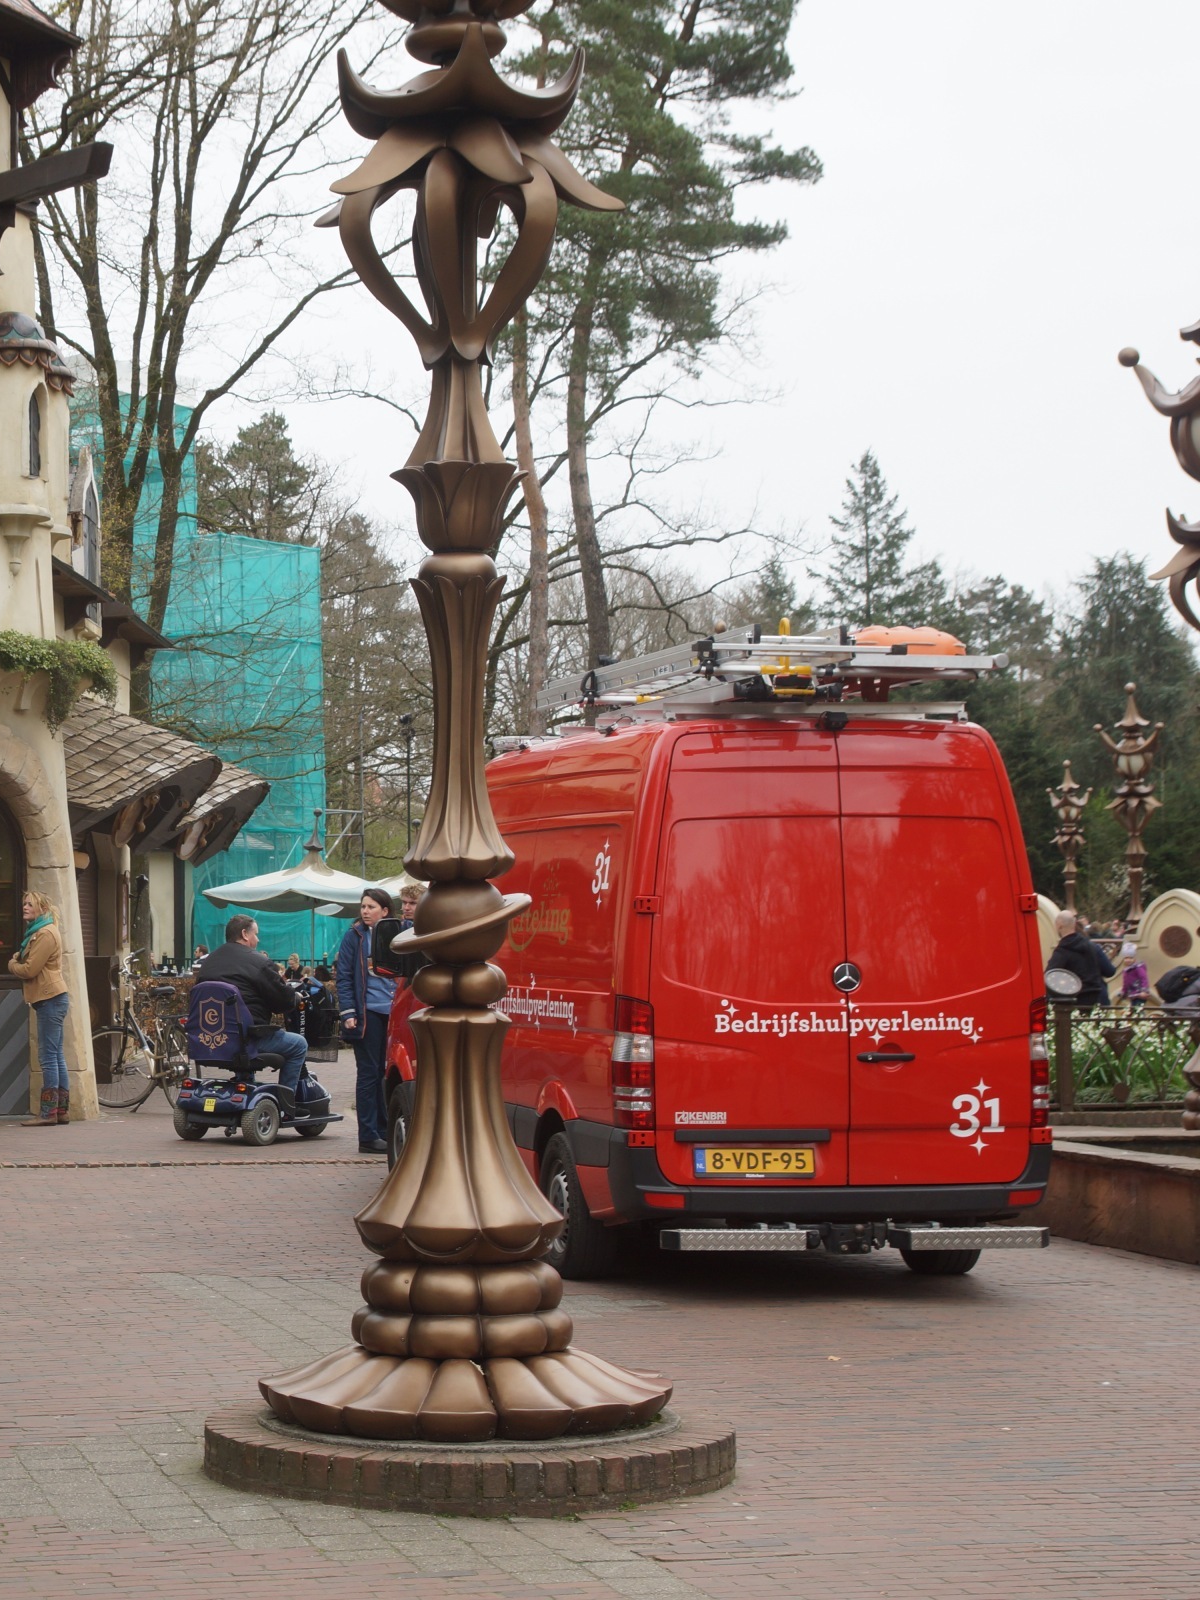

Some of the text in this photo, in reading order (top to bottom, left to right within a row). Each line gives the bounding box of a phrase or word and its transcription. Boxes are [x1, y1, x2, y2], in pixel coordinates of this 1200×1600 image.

[592, 852, 611, 894] 31
[487, 988, 575, 1026] rijfshulpverlening
[715, 1011, 974, 1038] Bedrijfshulpverlening
[688, 1111, 727, 1120] KENBRI
[949, 1093, 1006, 1138] 31
[712, 1152, 807, 1170] 8-VDF-95
